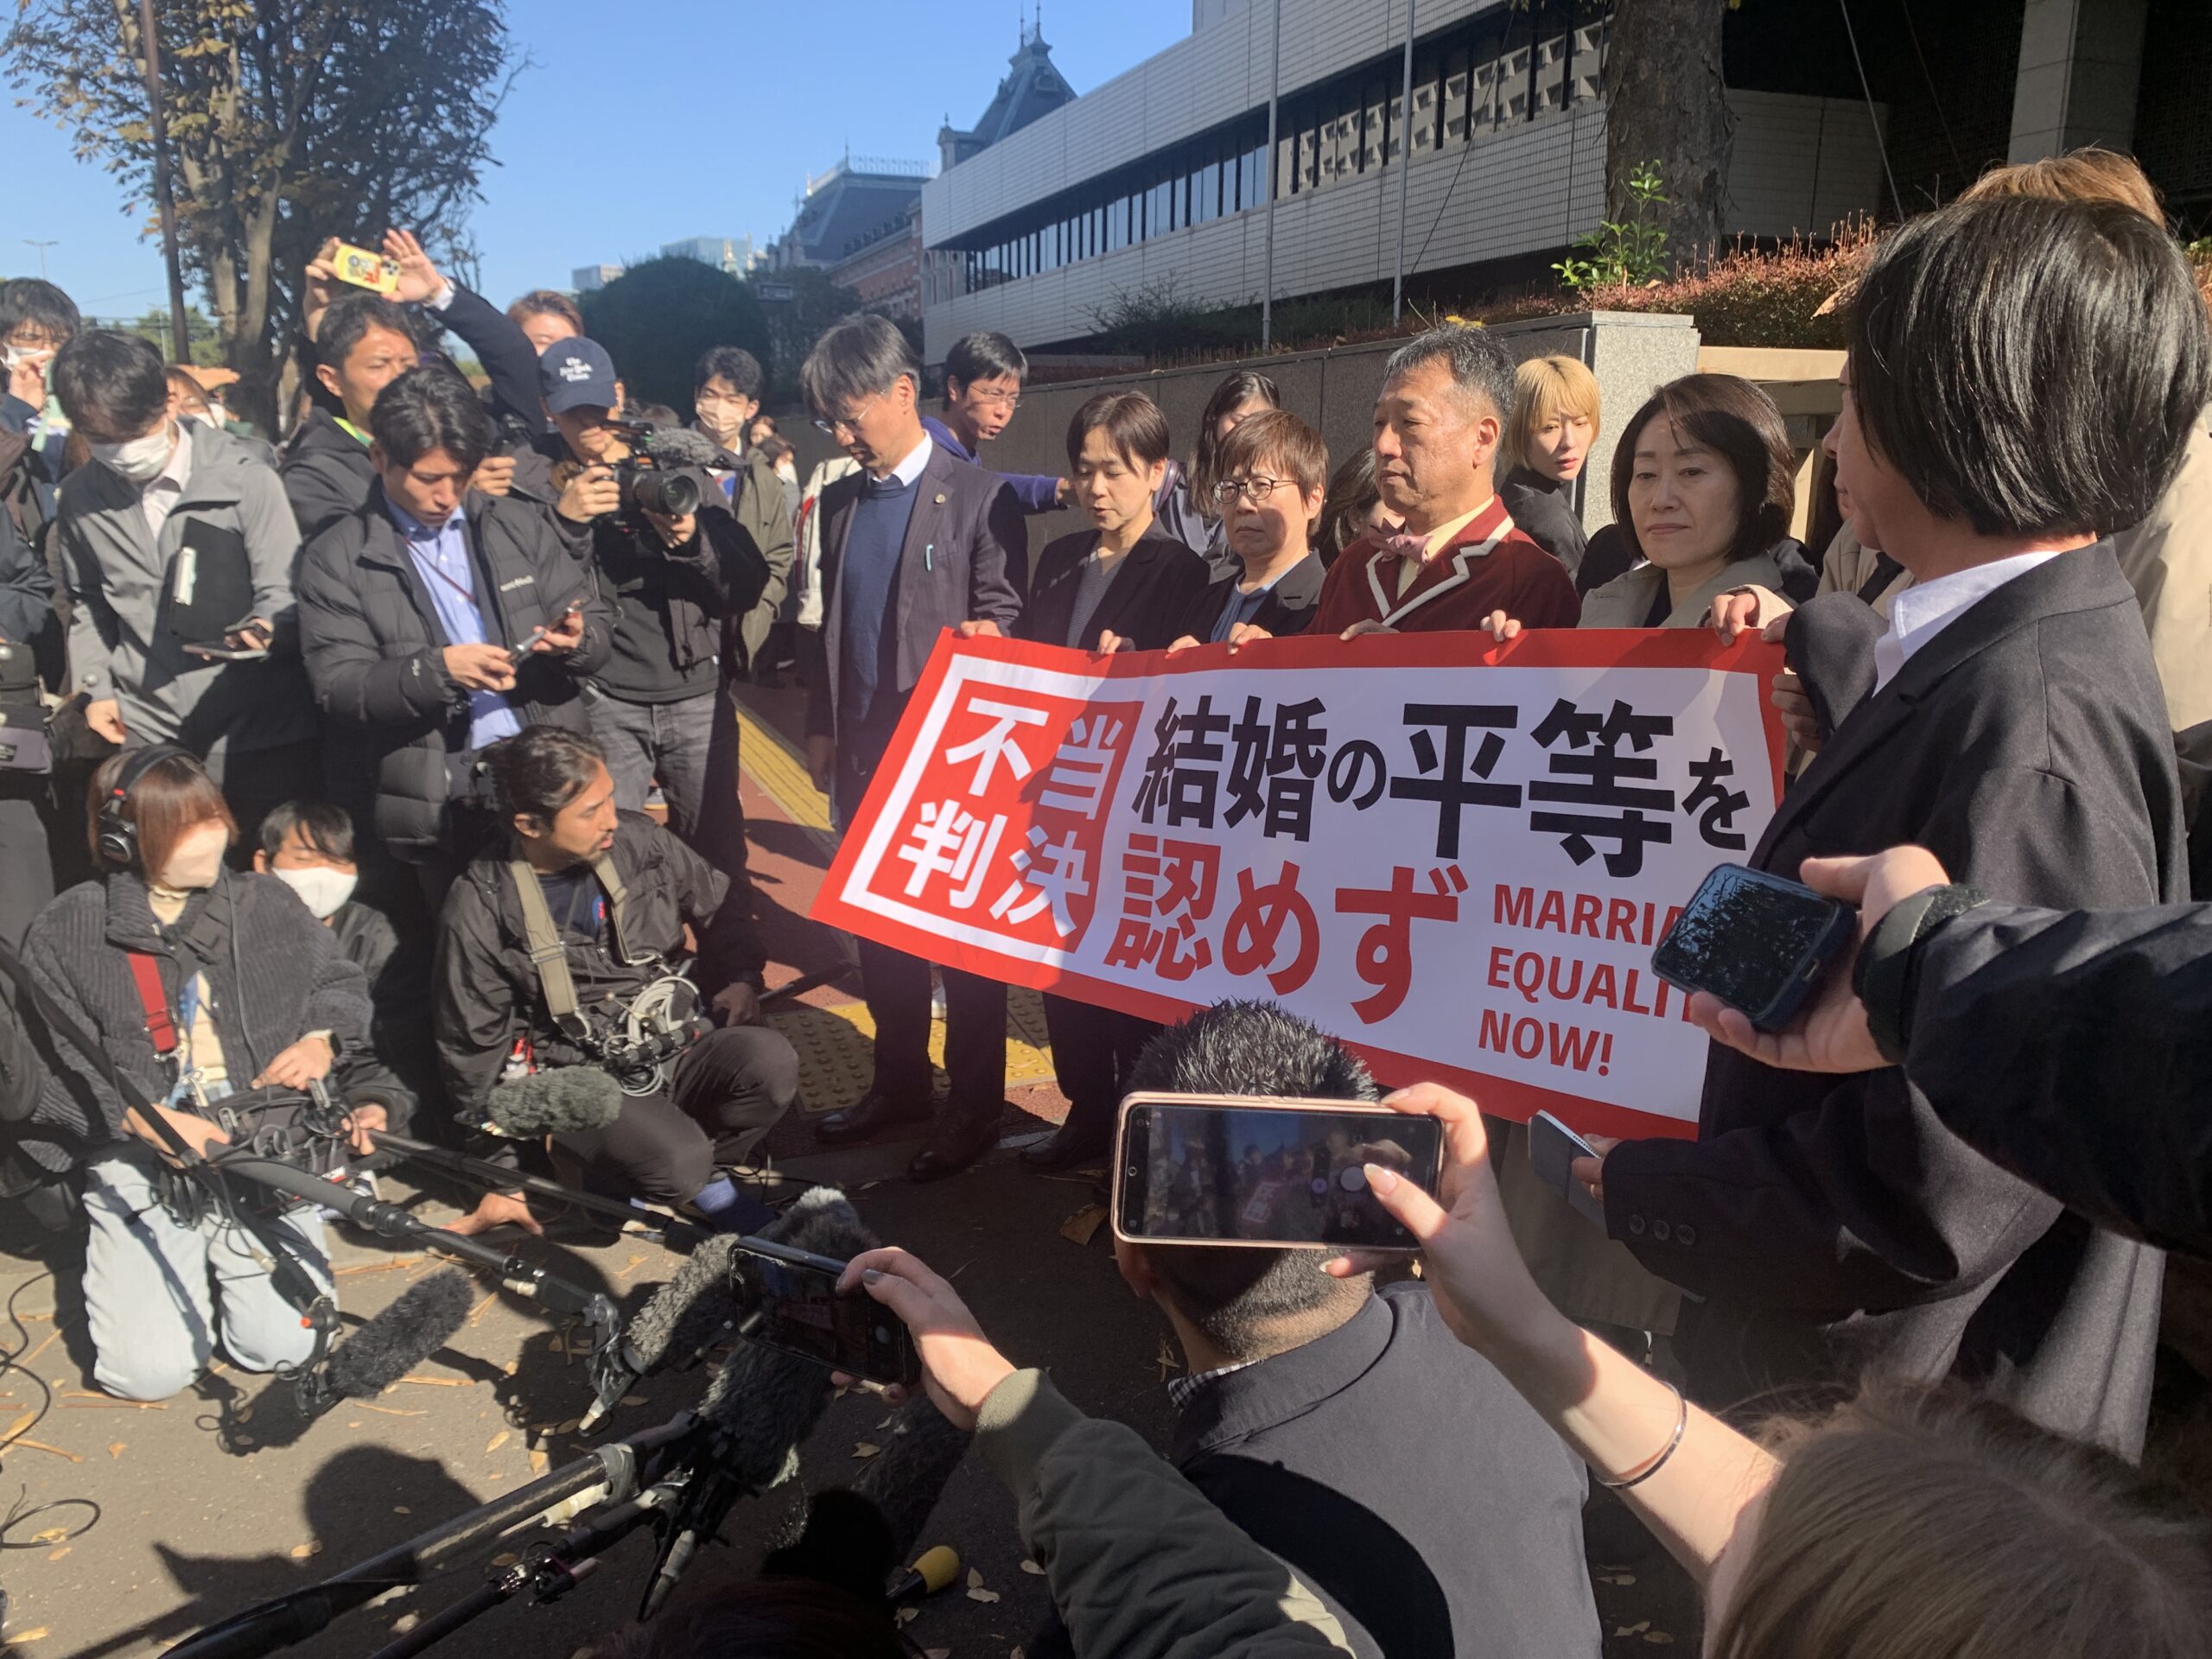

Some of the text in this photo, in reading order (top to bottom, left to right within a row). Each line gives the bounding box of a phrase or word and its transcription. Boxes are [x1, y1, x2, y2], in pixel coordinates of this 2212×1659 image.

[944, 696, 1123, 821] 不当
[1130, 695, 1751, 879] 結婚の平等を
[897, 798, 1090, 938] 判決
[1102, 831, 1469, 1026] 認めず
[1493, 883, 1686, 948] MARRI
[1478, 1008, 1614, 1077] NOW!
[1486, 945, 1693, 1024] EQUALI
